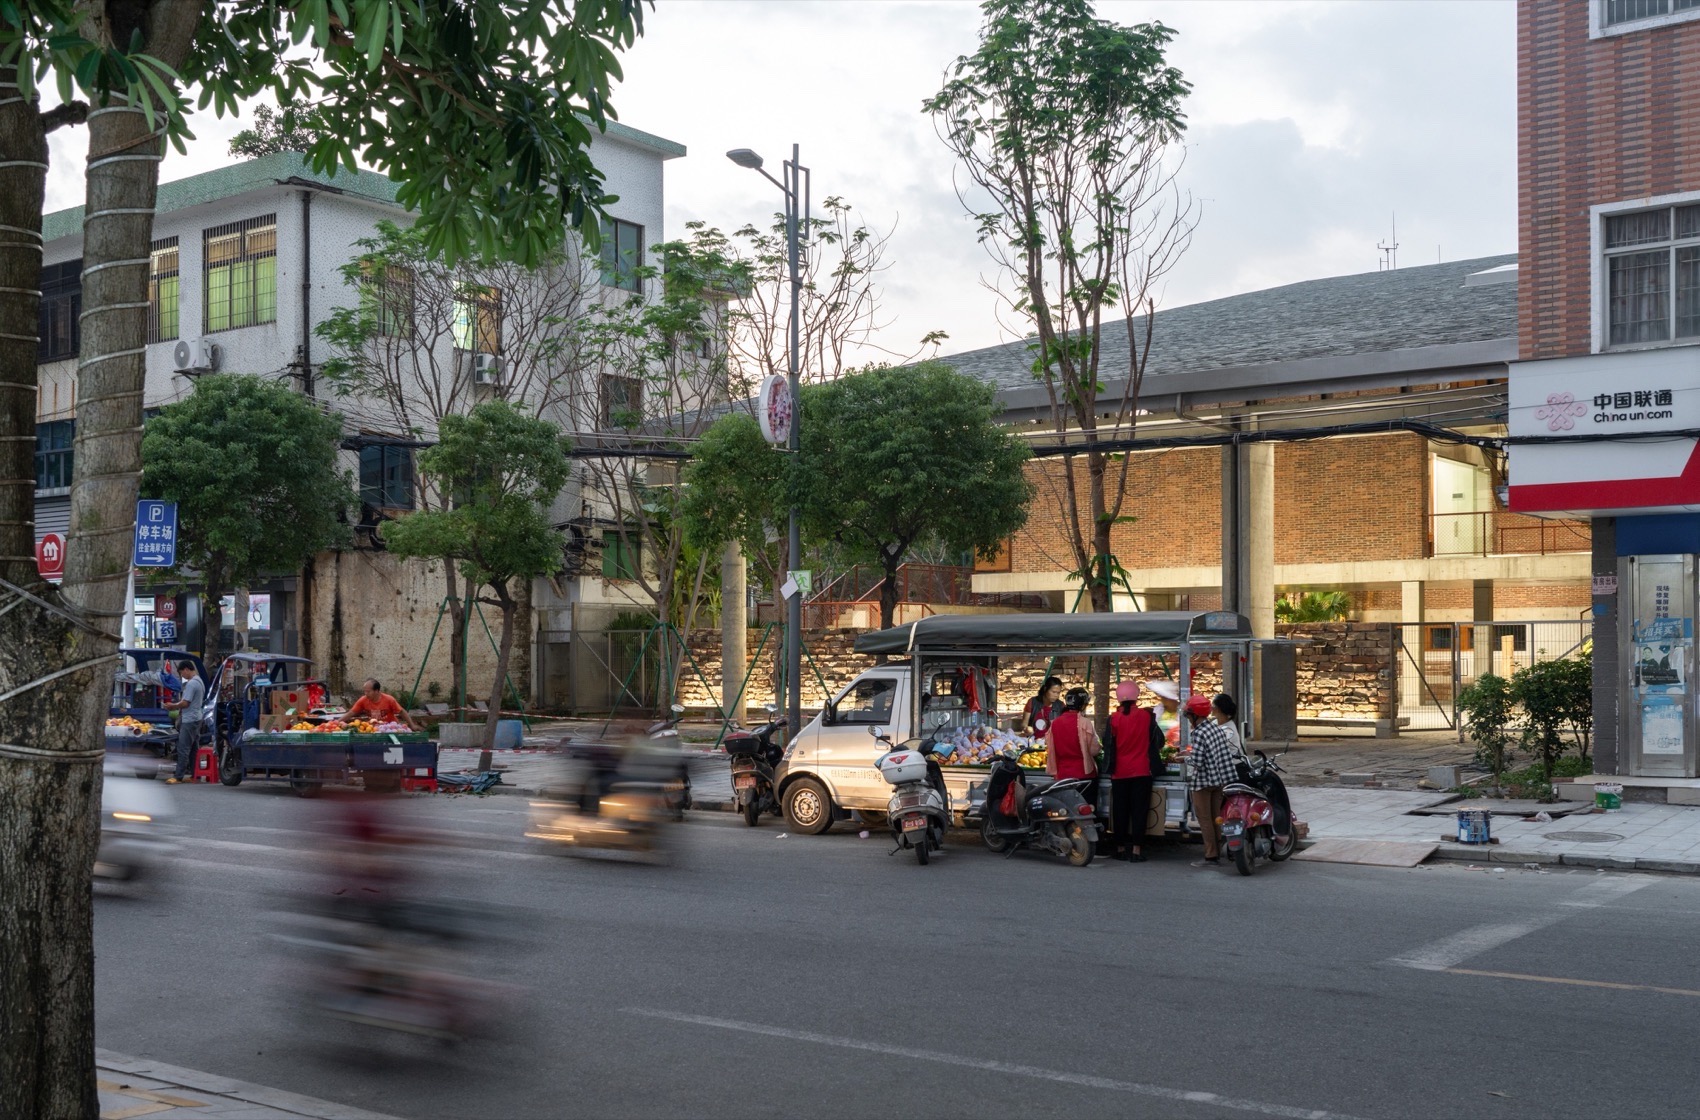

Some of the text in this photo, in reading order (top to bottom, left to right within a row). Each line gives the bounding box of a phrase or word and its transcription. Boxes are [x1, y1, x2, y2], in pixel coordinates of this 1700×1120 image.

[1594, 389, 1672, 410] 中国联通
[1594, 410, 1672, 423] China unicom
[151, 507, 162, 520] P
[139, 525, 172, 540] 停车场
[160, 622, 174, 637] 药
